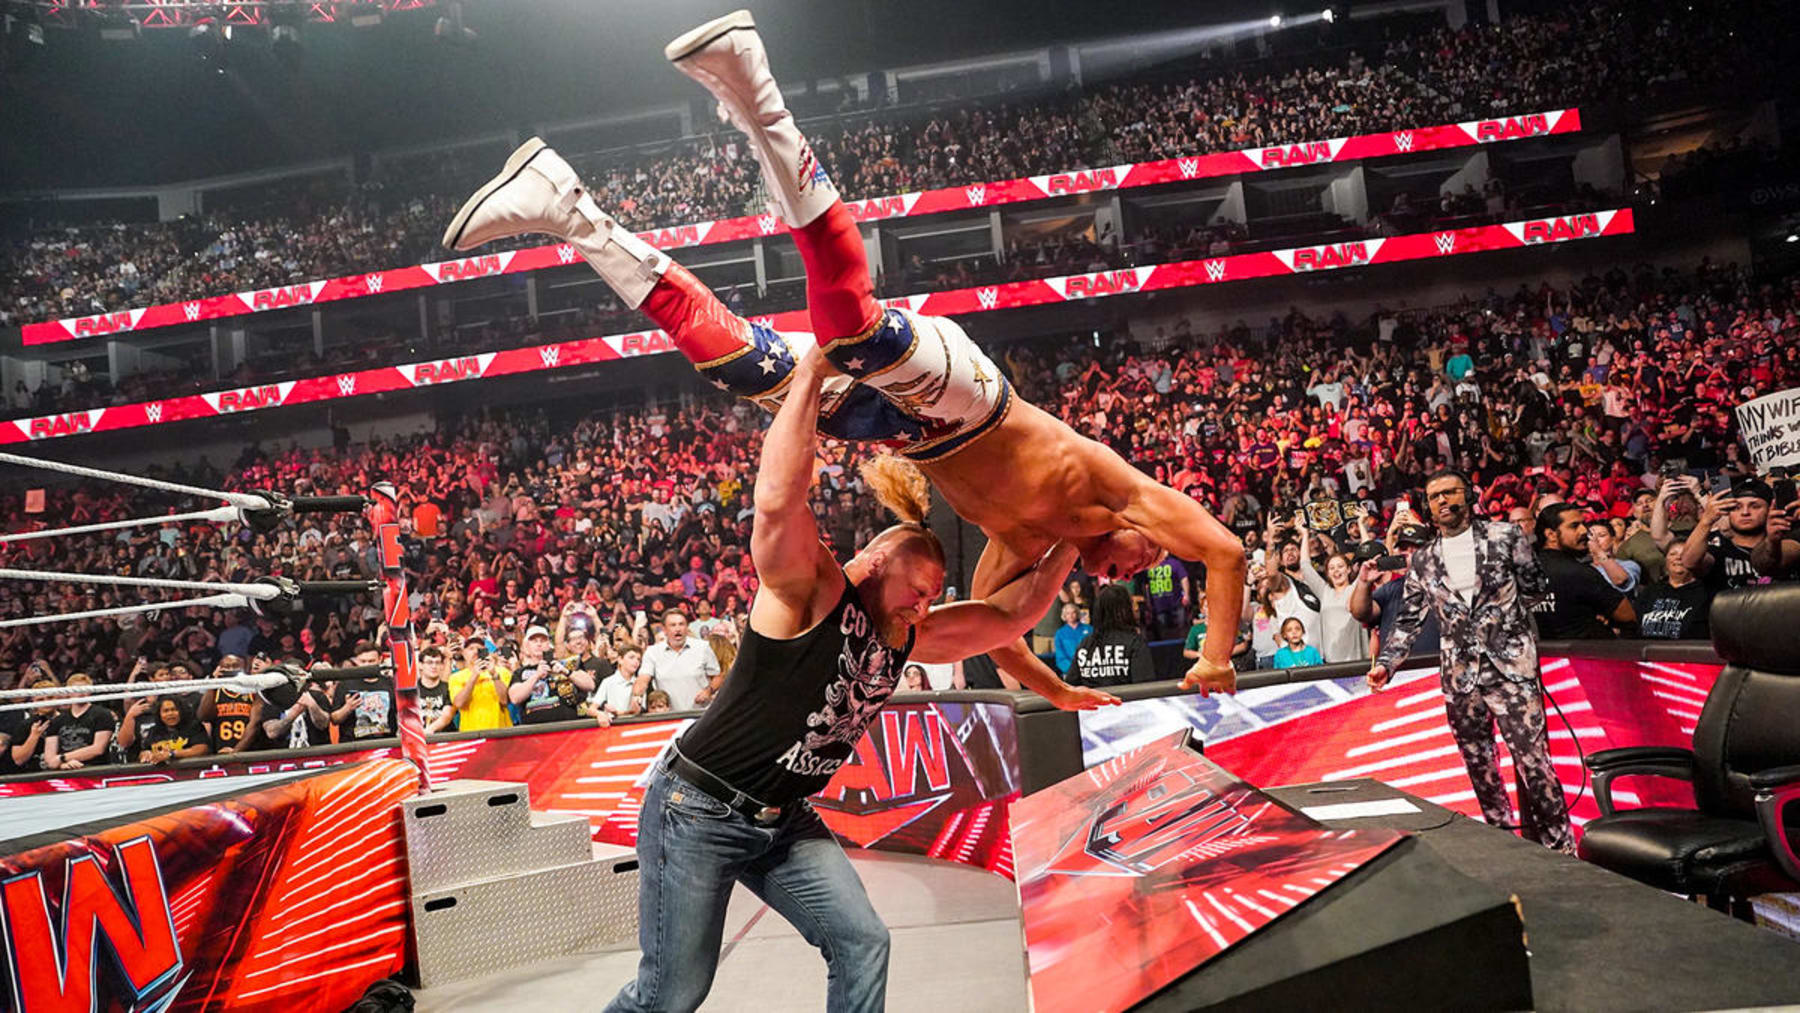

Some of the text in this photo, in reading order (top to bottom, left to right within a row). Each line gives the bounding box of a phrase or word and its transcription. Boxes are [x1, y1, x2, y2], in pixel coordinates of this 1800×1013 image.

[1477, 114, 1549, 142] RAW
[1262, 141, 1332, 168] RAW
[1048, 168, 1117, 195] RAW
[1524, 214, 1600, 244] RAW
[439, 255, 501, 281] RAW
[1294, 242, 1367, 270] RAW
[1065, 270, 1139, 298] RAW
[253, 284, 312, 312] RAW
[75, 312, 132, 337] RAW
[622, 330, 675, 354] RA
[414, 356, 481, 386] RAW
[218, 385, 281, 412] RAW
[30, 412, 91, 439] RAW
[1739, 403, 1765, 434] MY
[1749, 425, 1784, 450] THINKS
[1077, 645, 1129, 667] S.A.F.E.
[220, 721, 245, 741] 69
